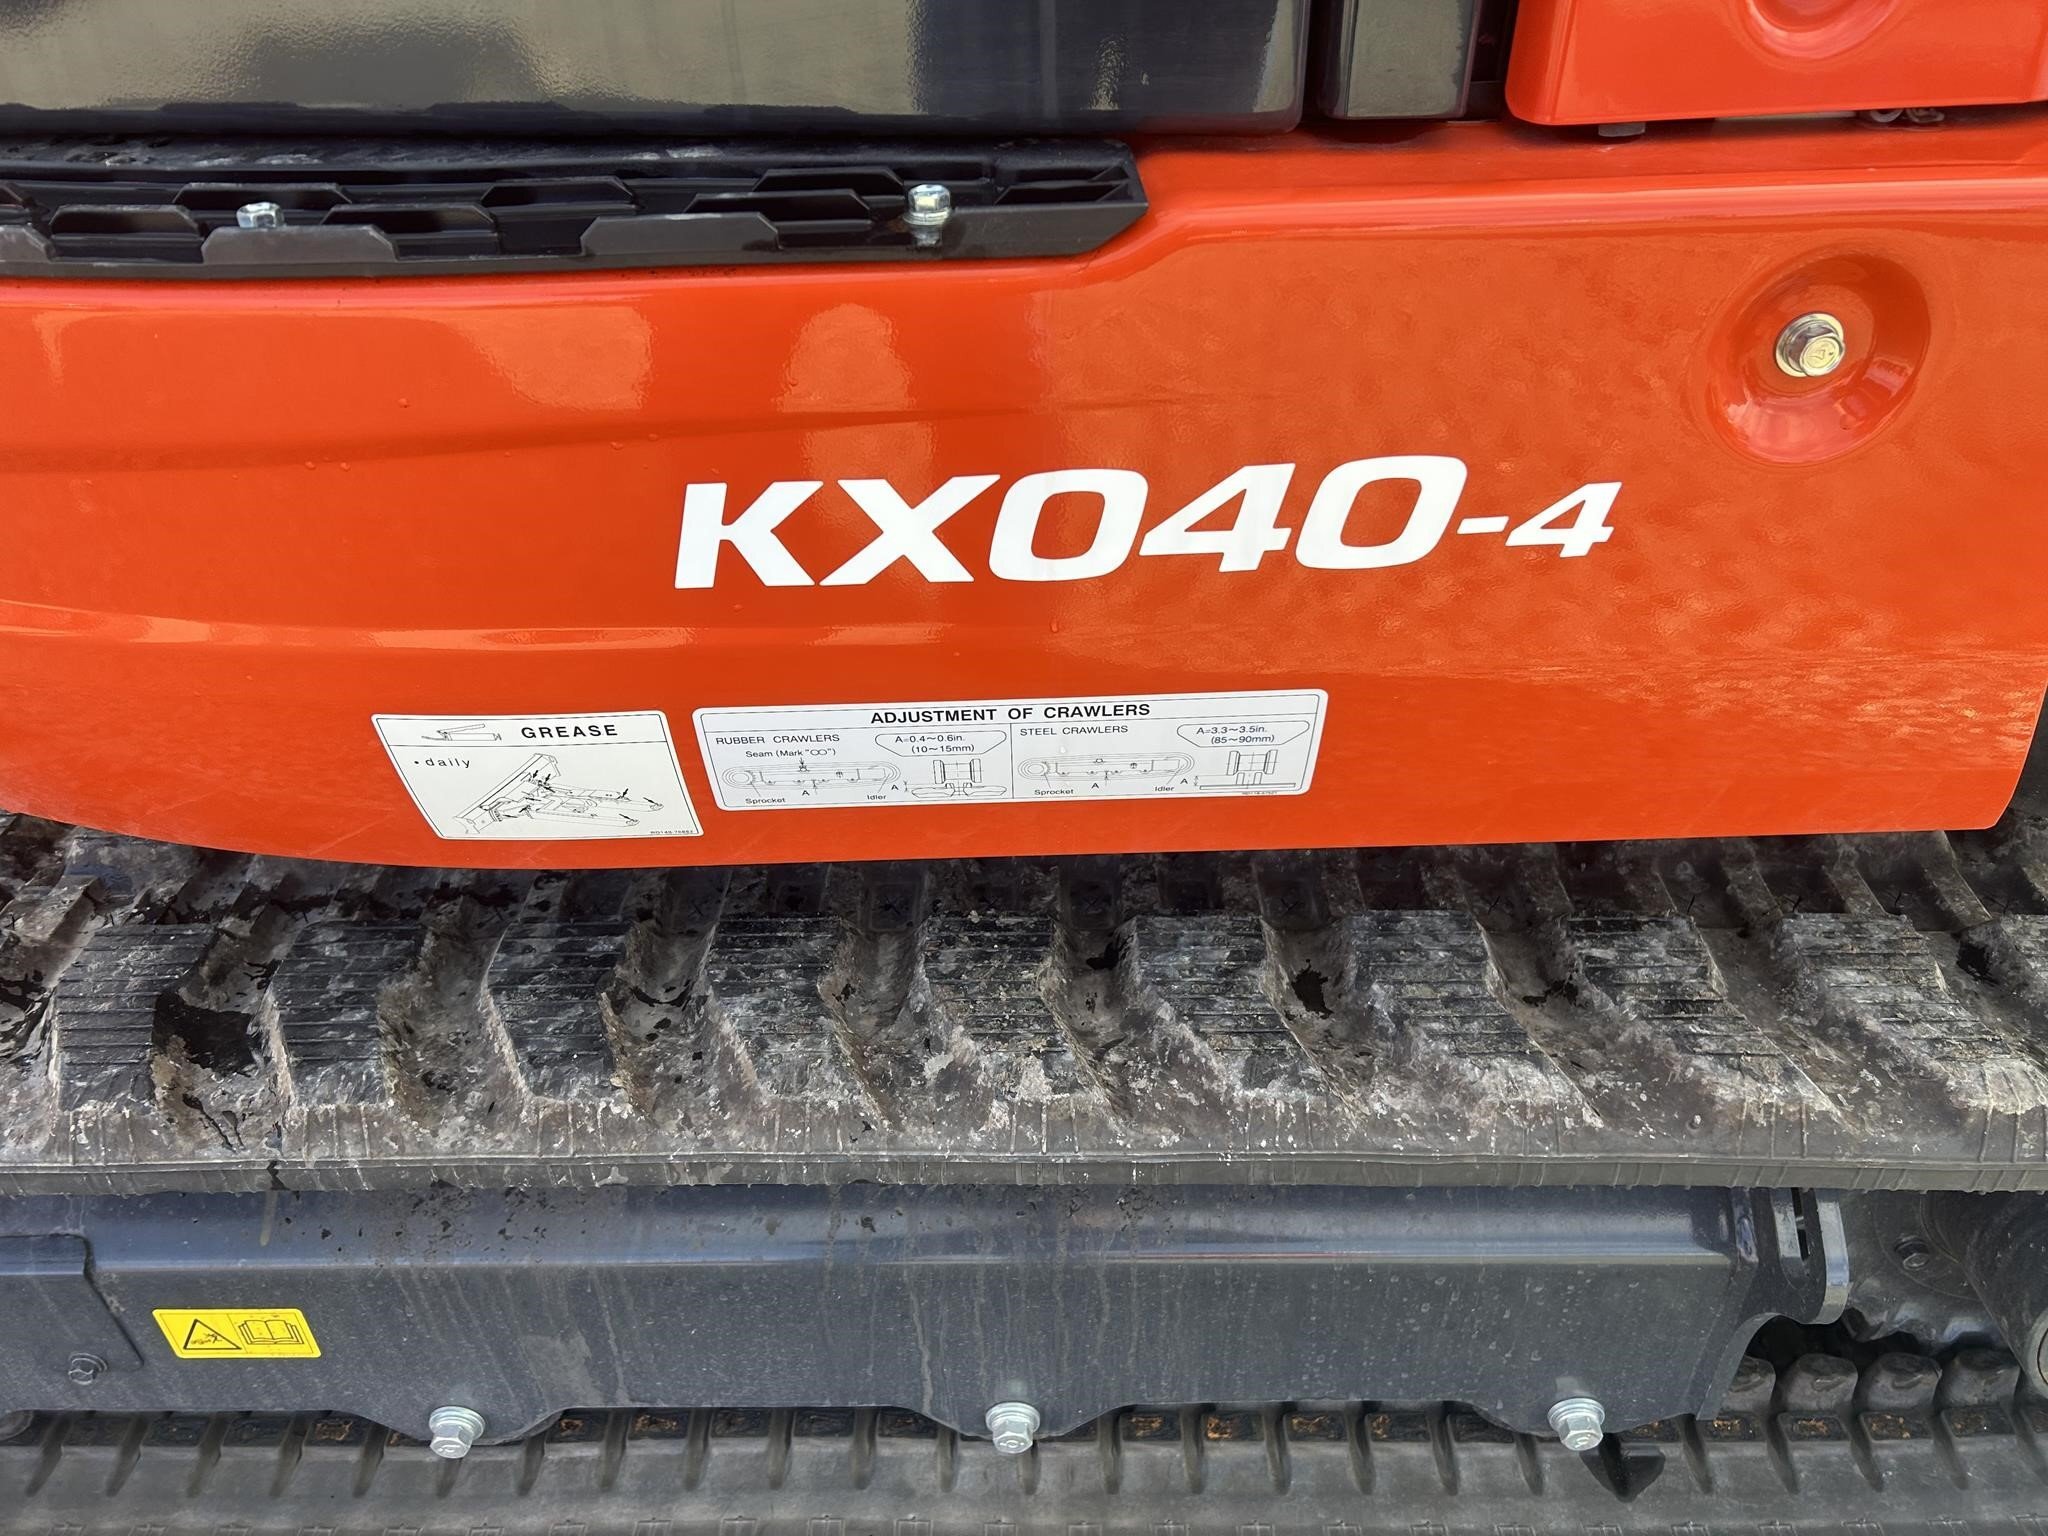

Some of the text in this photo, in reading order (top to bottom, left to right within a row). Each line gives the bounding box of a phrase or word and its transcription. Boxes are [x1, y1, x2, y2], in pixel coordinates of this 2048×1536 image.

[674, 455, 1623, 589] KX040-4
[871, 703, 1151, 724] ADJUSTMENT OF CRAWLERS
[521, 724, 619, 739] GREASE
[1020, 725, 1129, 736] STEEL CRAWLERS
[715, 734, 840, 745] RUBBER CRAWLERS
[745, 750, 773, 758] Seam
[425, 756, 471, 769] daily
[1034, 788, 1074, 797] Sprocket
[1154, 785, 1175, 793] Idler
[745, 797, 786, 805] Sprocket
